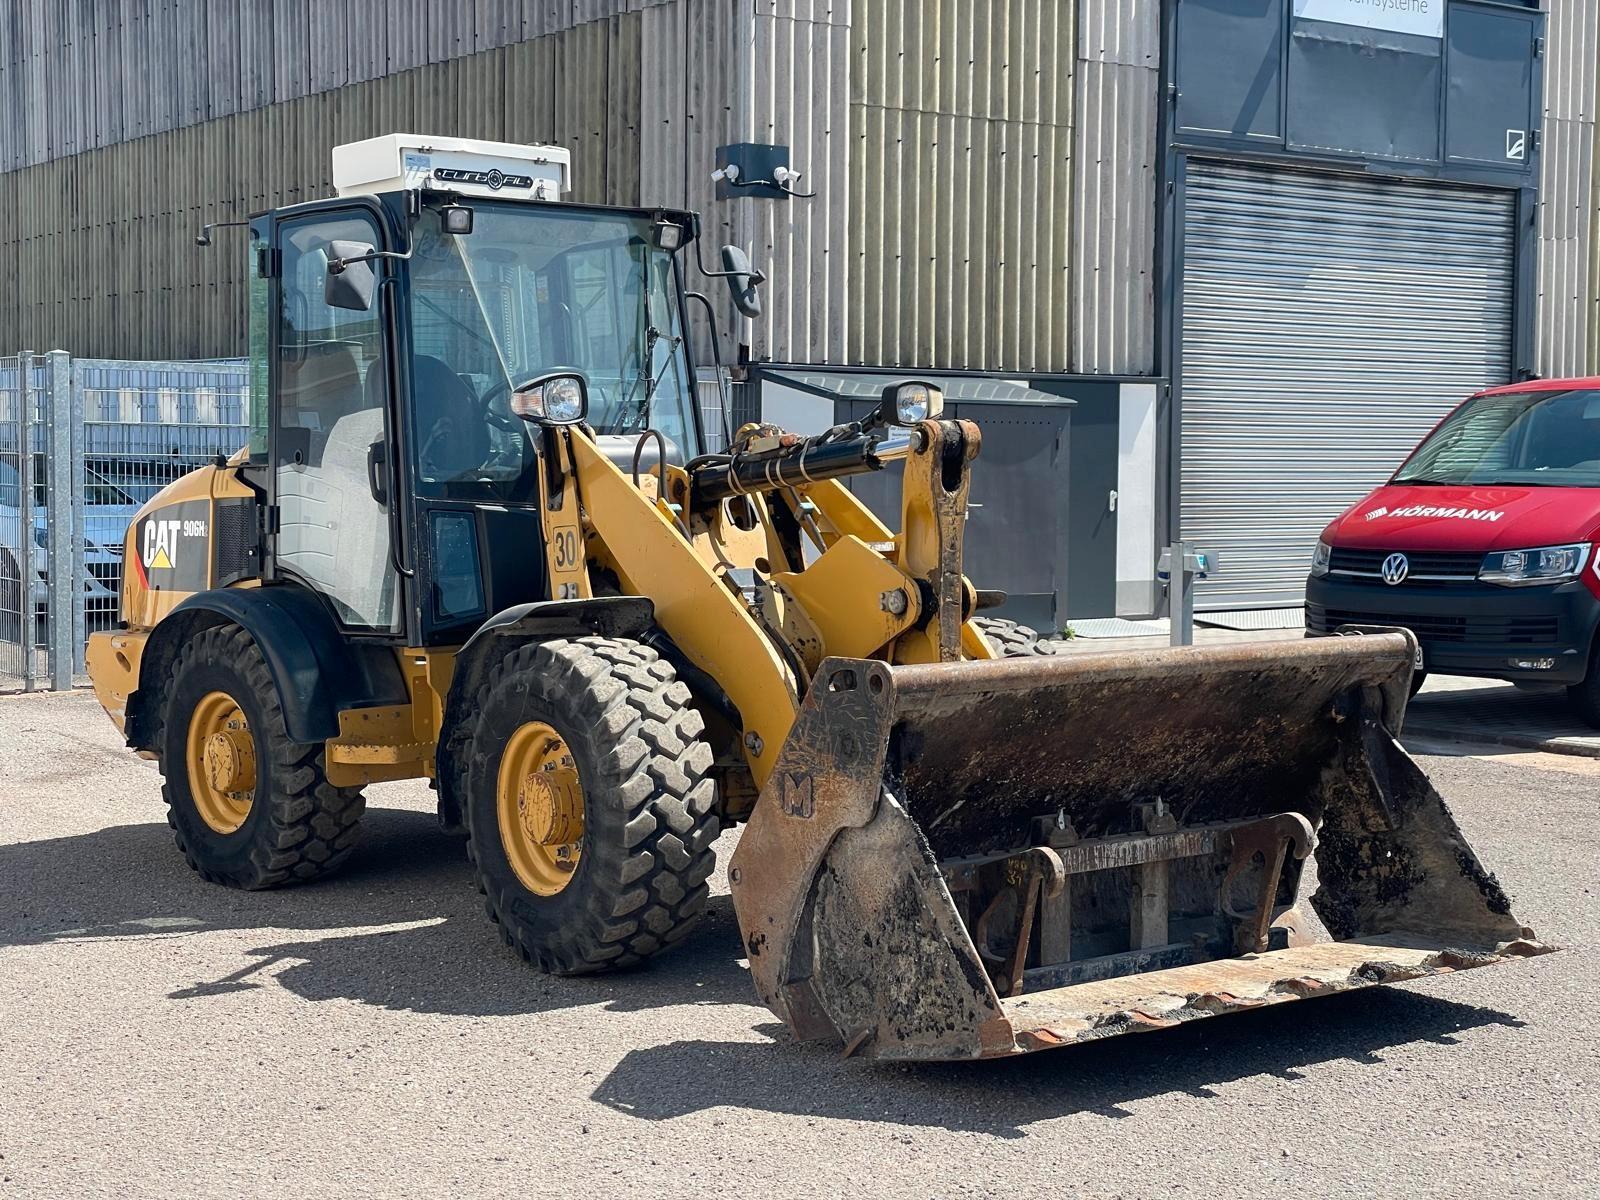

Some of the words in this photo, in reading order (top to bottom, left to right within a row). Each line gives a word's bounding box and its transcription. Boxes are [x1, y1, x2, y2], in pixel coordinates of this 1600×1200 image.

[1387, 505, 1504, 521] HÖRMANN
[143, 519, 181, 569] CAT
[555, 530, 576, 567] 30
